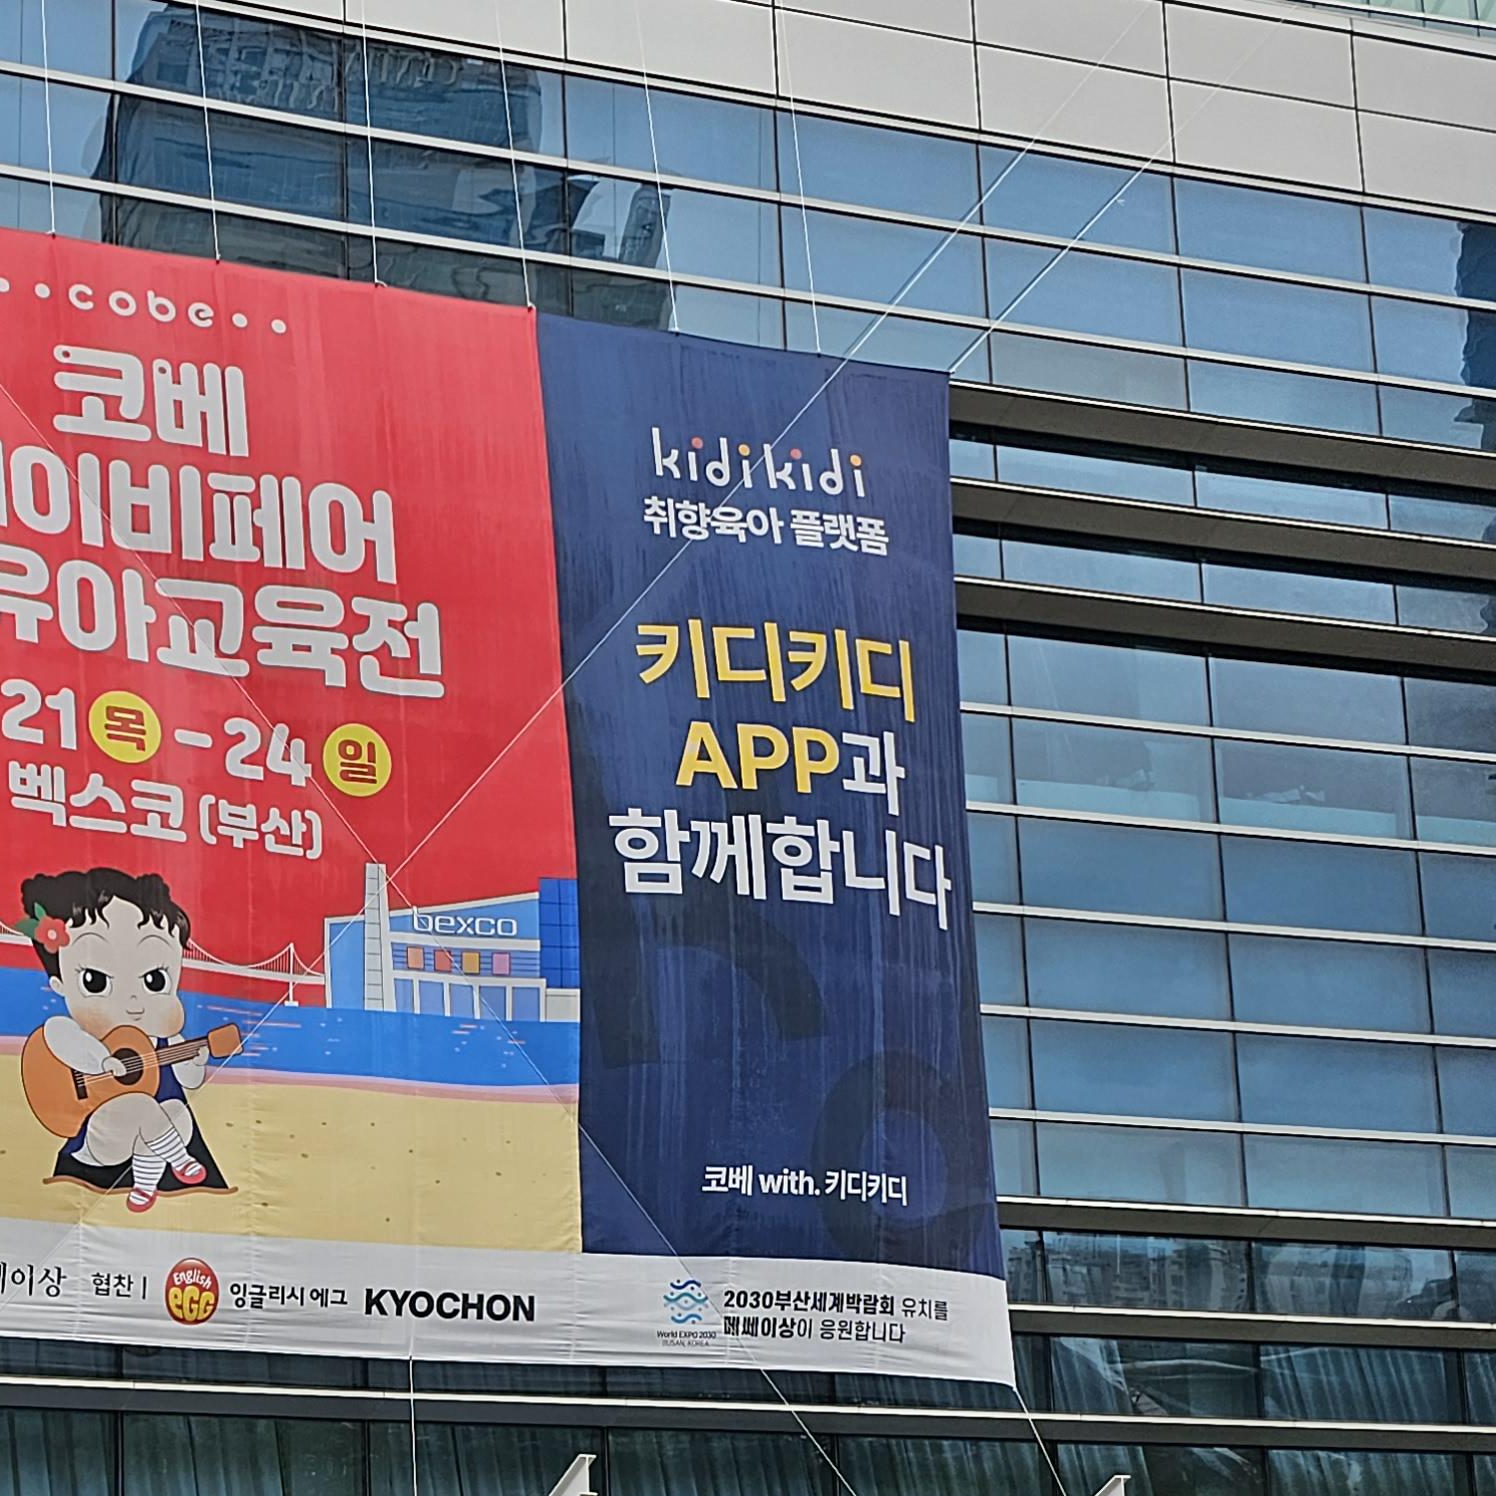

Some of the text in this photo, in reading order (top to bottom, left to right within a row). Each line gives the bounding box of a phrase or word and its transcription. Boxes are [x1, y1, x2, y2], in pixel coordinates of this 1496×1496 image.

[69, 283, 215, 328] cobe
[53, 344, 249, 457] 코베
[651, 427, 865, 497] kidikidi
[644, 495, 890, 556] 취향육아 플랫폼
[636, 619, 916, 723] 키디키디
[675, 720, 906, 817] APP과
[8, 761, 323, 860] 벡스코 (부산)
[608, 807, 953, 931] 함께합니다
[412, 905, 518, 937] bexco
[702, 1164, 908, 1206] 코베 with. 키디키디
[92, 1271, 134, 1299] 협찬
[172, 1267, 213, 1291] English
[229, 1283, 349, 1310] 잉글리시 에그
[363, 1286, 536, 1322] KYOCHON
[722, 1289, 949, 1322] 2030부산세계박람회 유치를
[722, 1316, 906, 1344] 메쎄이상이 응원합니다
